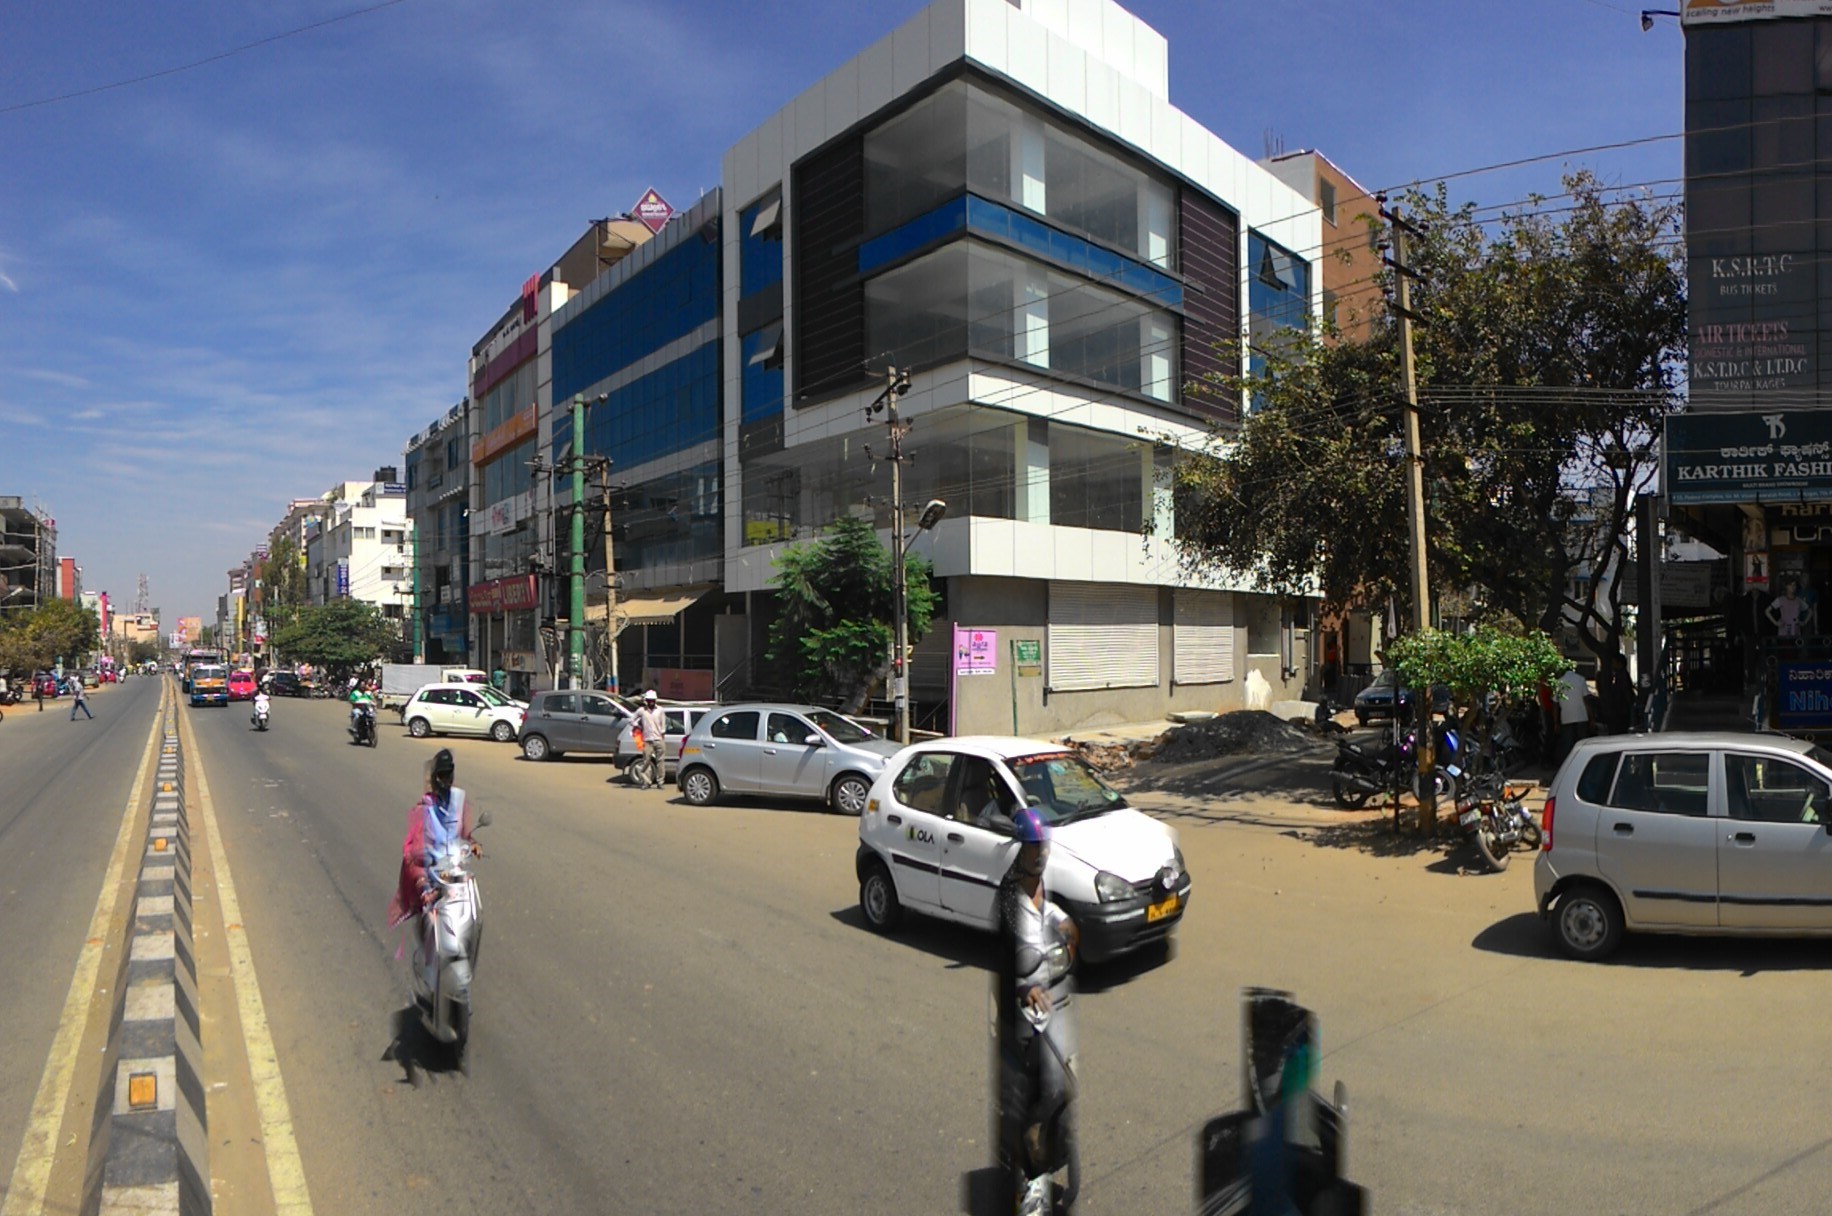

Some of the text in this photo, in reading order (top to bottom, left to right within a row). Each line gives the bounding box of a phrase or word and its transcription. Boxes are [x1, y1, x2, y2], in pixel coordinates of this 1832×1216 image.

[1686, 4, 1775, 18] scaling new heights
[1720, 285, 1738, 295] BUS
[1697, 321, 1788, 343] AIR TICKETS
[1752, 361, 1762, 376] &
[1677, 464, 1768, 480] KARTHIK
[917, 830, 935, 844] OLA
